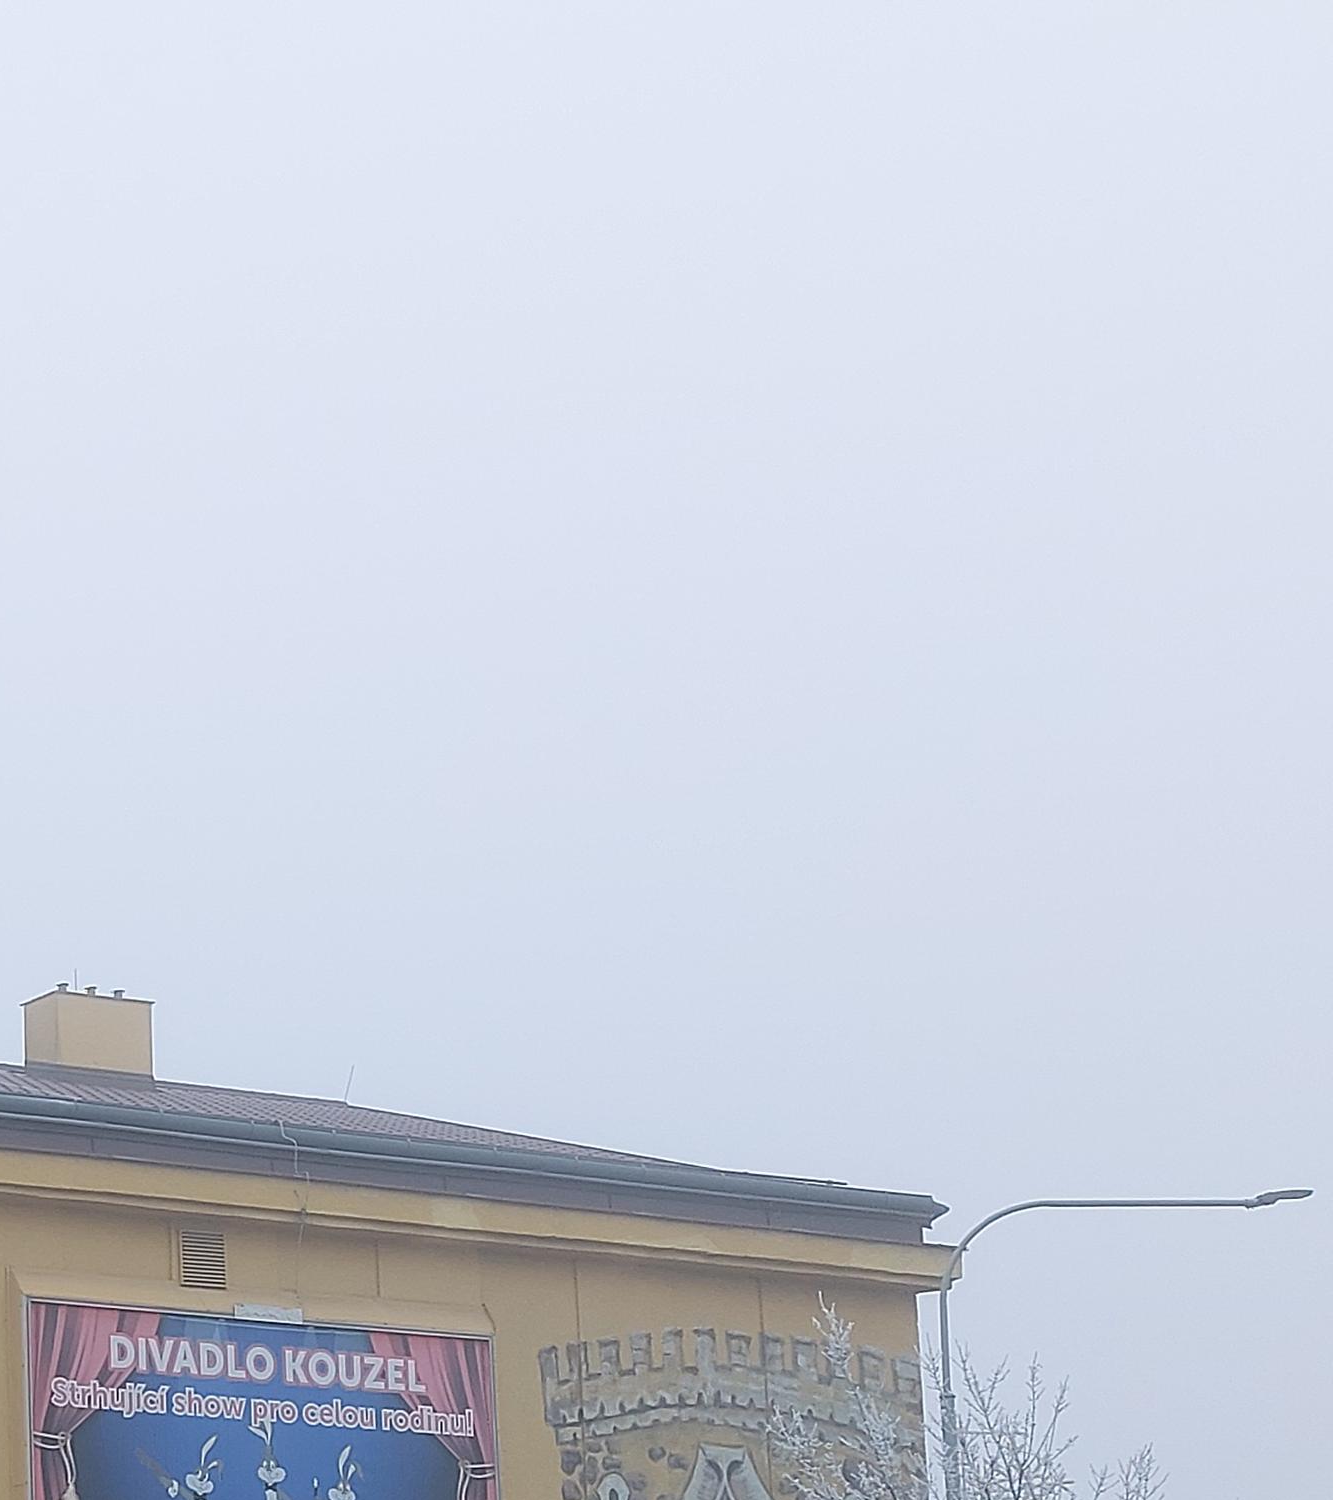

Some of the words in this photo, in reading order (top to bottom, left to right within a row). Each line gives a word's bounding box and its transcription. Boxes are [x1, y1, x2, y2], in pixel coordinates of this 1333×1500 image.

[108, 1332, 275, 1382] DIVADLO
[284, 1348, 428, 1394] KOUZEL
[50, 1376, 168, 1419] Strhující
[172, 1387, 246, 1420] show
[250, 1399, 299, 1429] pro
[302, 1398, 377, 1431] celou
[381, 1404, 475, 1438] rodinu!
